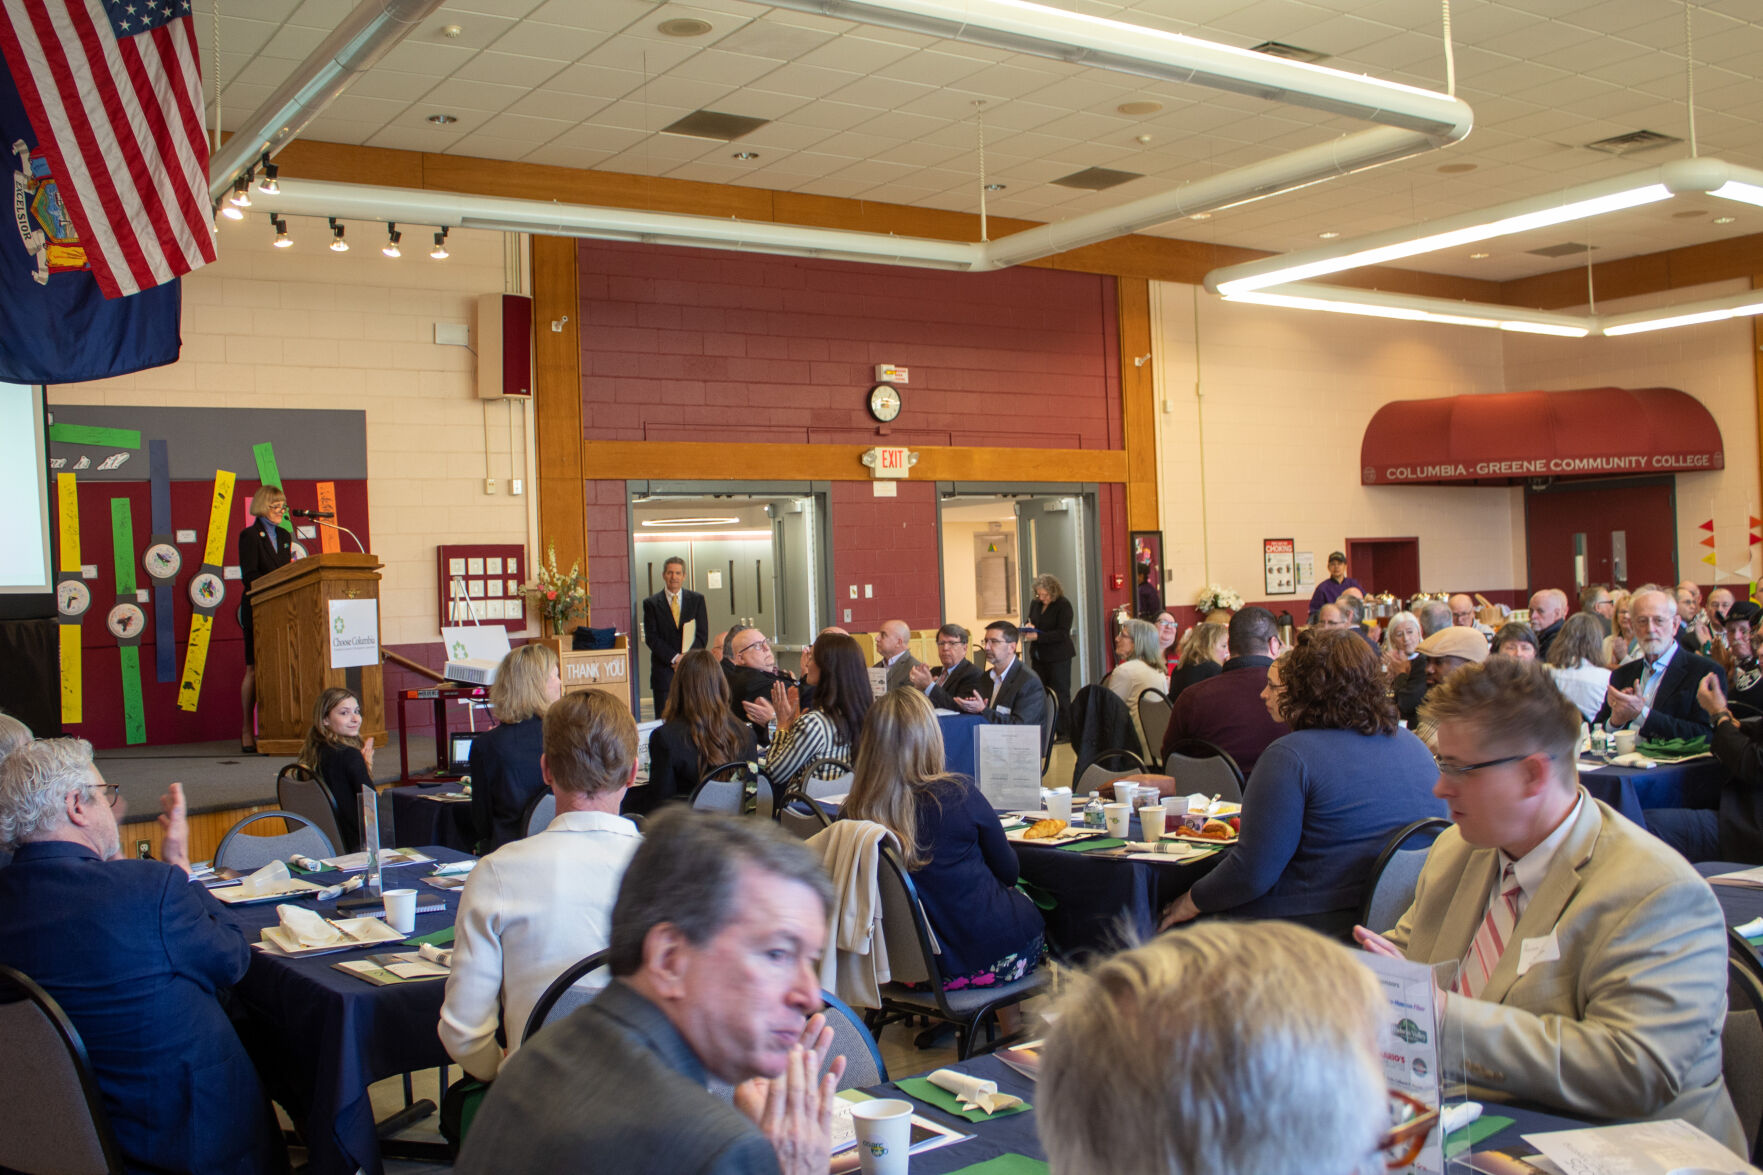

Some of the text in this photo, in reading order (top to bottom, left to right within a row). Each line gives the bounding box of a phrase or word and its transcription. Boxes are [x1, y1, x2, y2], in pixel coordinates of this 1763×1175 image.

[15, 181, 32, 240] EXCELSIOR
[882, 450, 904, 469] EXIT
[1386, 464, 1467, 480] COLUMBIA
[1476, 459, 1547, 475] GREENE
[1550, 456, 1647, 471] COMMUNITY
[1652, 454, 1710, 467] COLLEGE
[333, 634, 376, 647] Choose Columbia
[566, 657, 624, 680] THANK YOU
